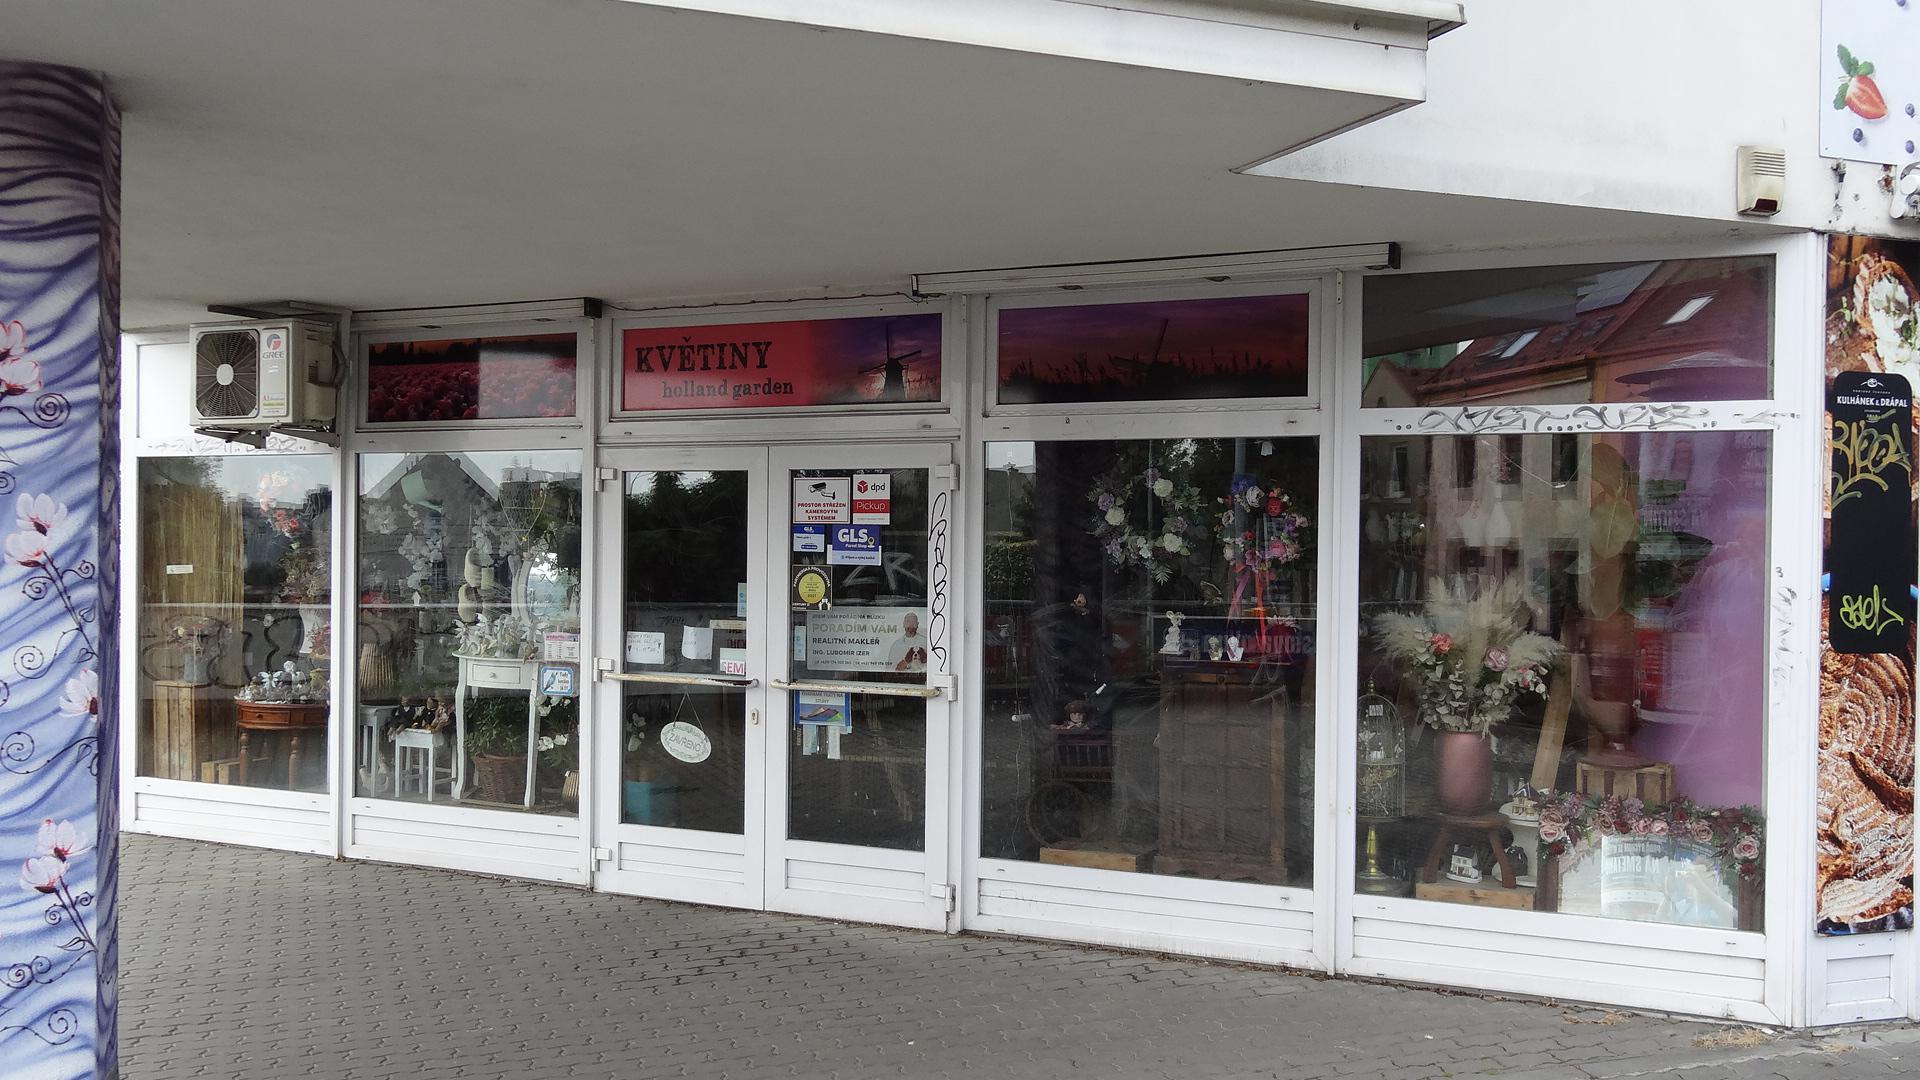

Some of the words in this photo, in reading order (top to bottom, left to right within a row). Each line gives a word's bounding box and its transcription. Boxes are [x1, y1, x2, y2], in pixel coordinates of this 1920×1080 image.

[262, 351, 285, 359] GREE
[635, 336, 772, 373] KVĚTINY
[662, 379, 728, 399] holland
[733, 377, 794, 400] garden
[1836, 395, 1875, 406] KULHÁNEK
[1880, 396, 1908, 408] DRÁPAL
[870, 483, 886, 492] dpd
[856, 501, 886, 512] Pickup
[837, 528, 868, 543] GLS
[812, 621, 867, 633] PORADÍM
[812, 636, 847, 645] REALITNÍ
[848, 637, 880, 646] MAKLÉŘ
